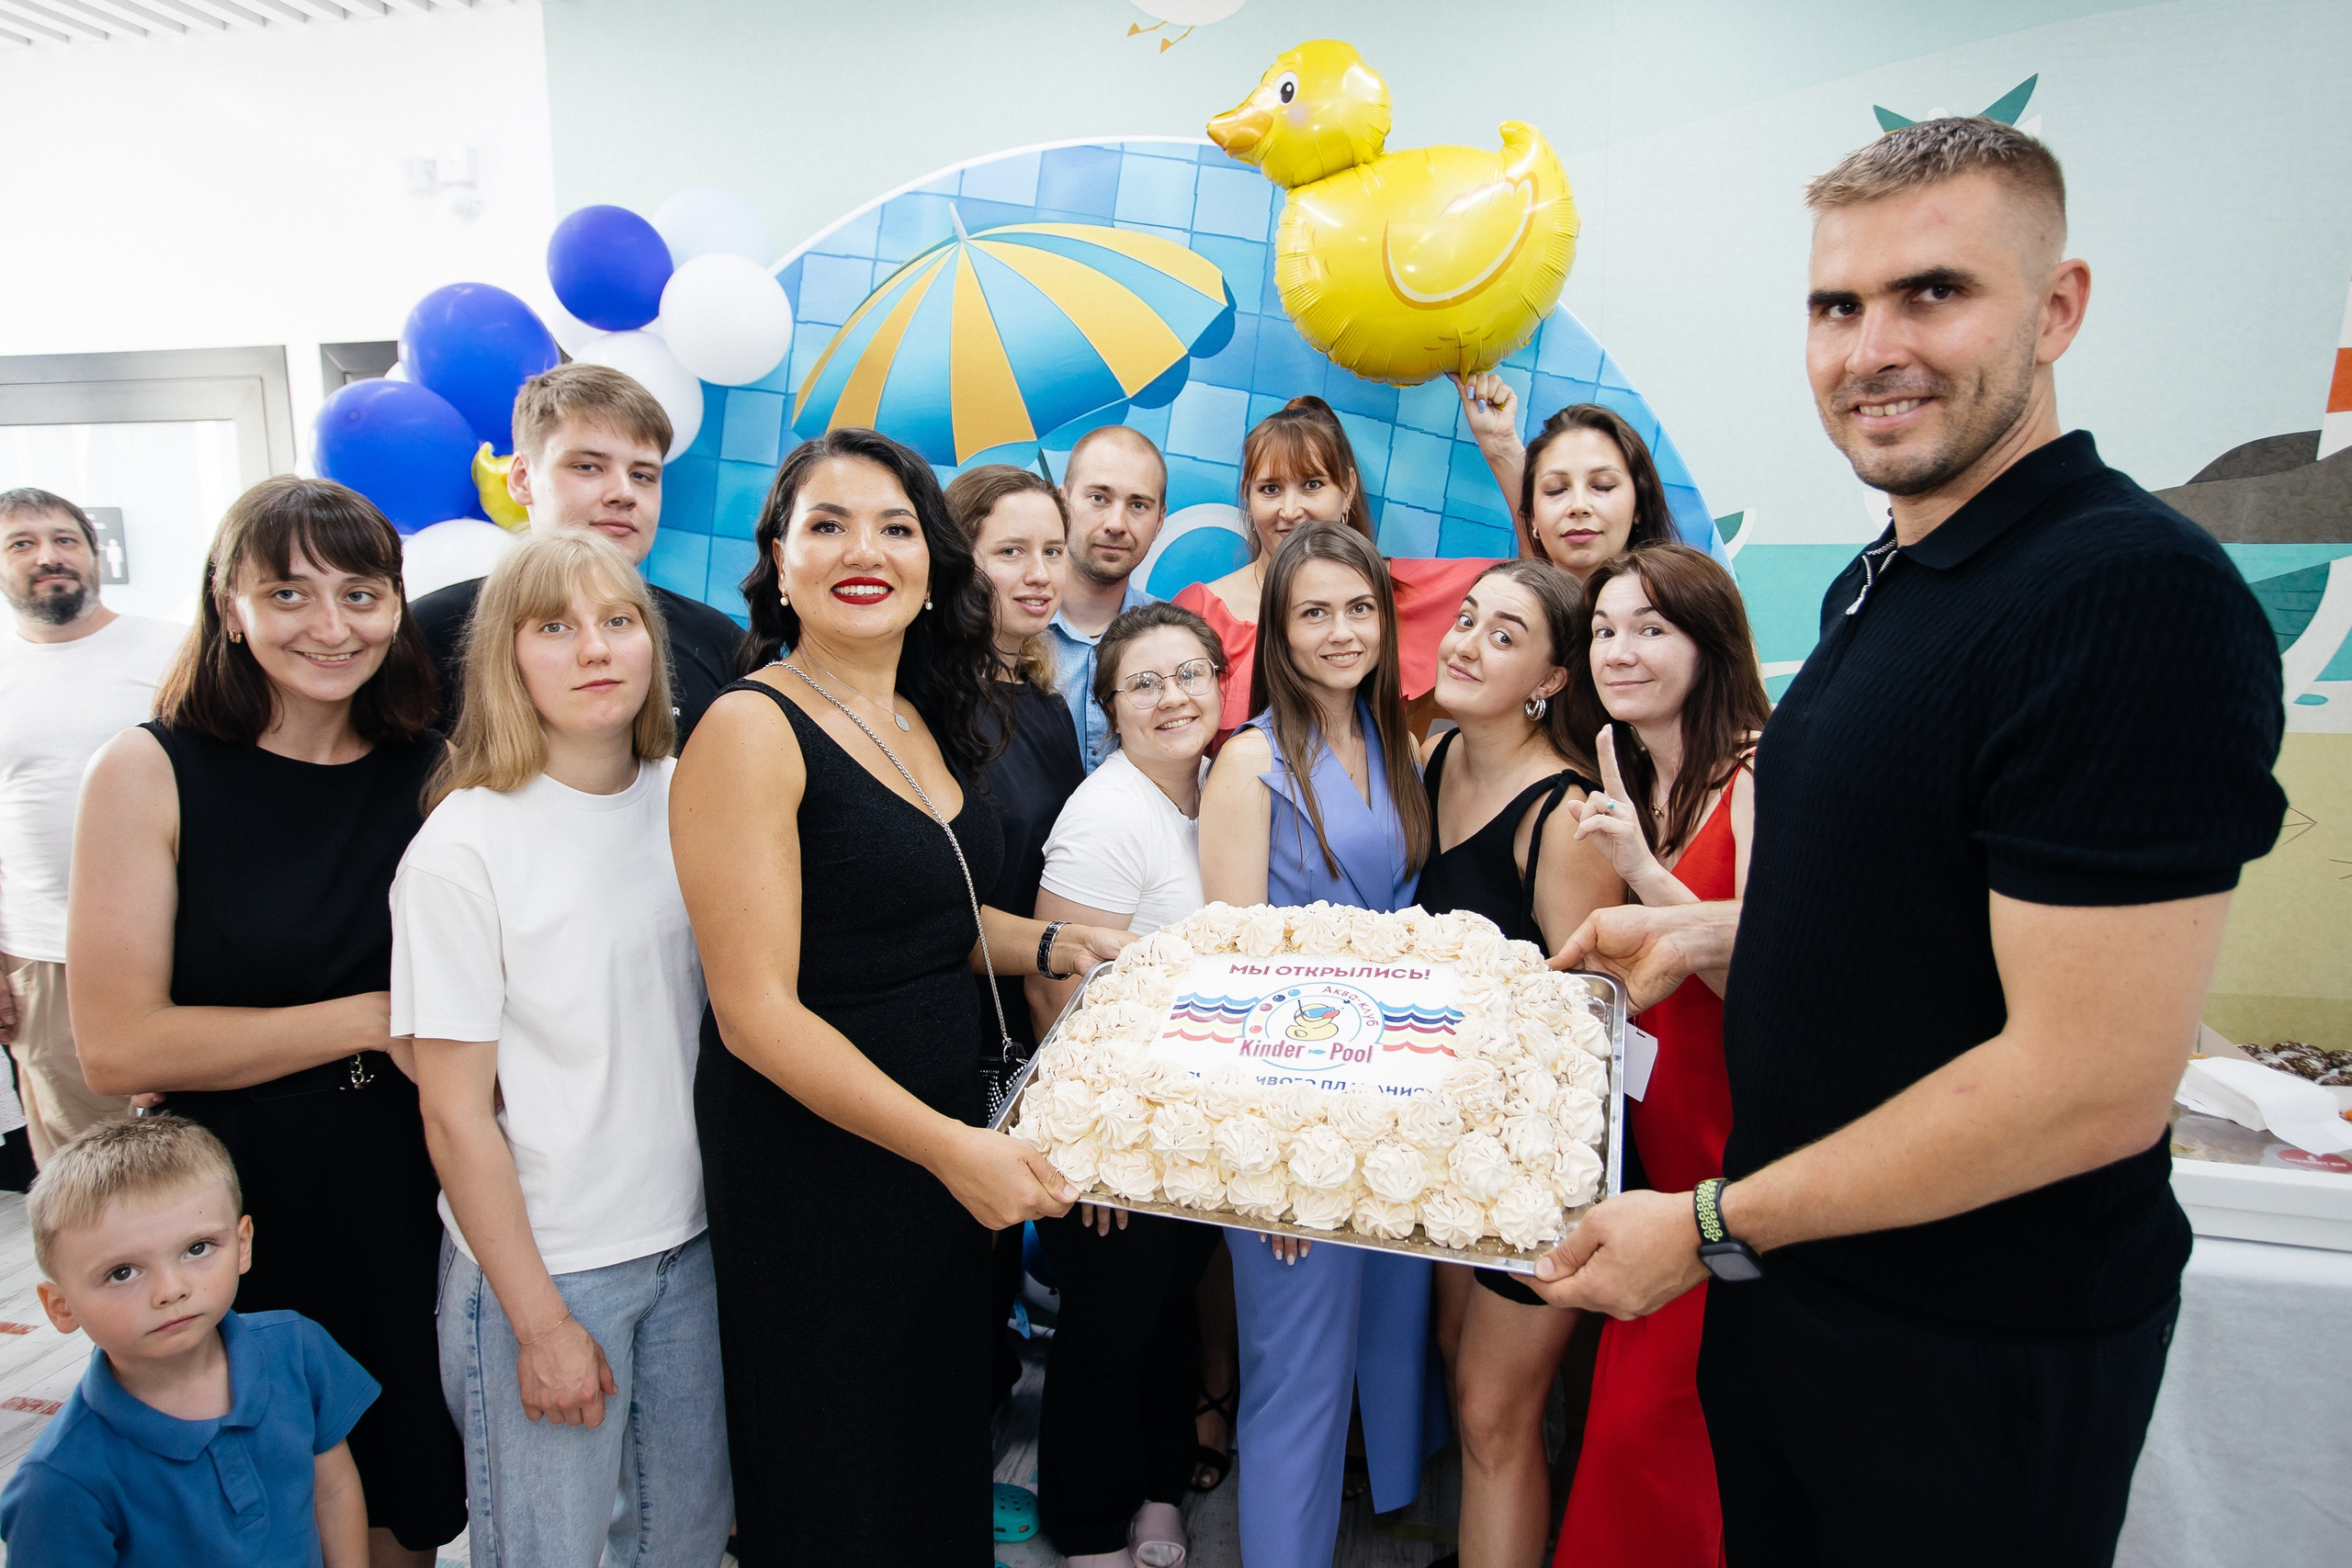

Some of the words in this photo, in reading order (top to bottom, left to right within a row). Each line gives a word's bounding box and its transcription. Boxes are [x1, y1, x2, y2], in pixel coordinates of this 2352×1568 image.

[1228, 964, 1271, 976] МЫ
[1275, 965, 1431, 980] ОТКРЫЛИСЬ!
[1239, 1039, 1306, 1059] Kinder
[1329, 1042, 1374, 1064] Pool
